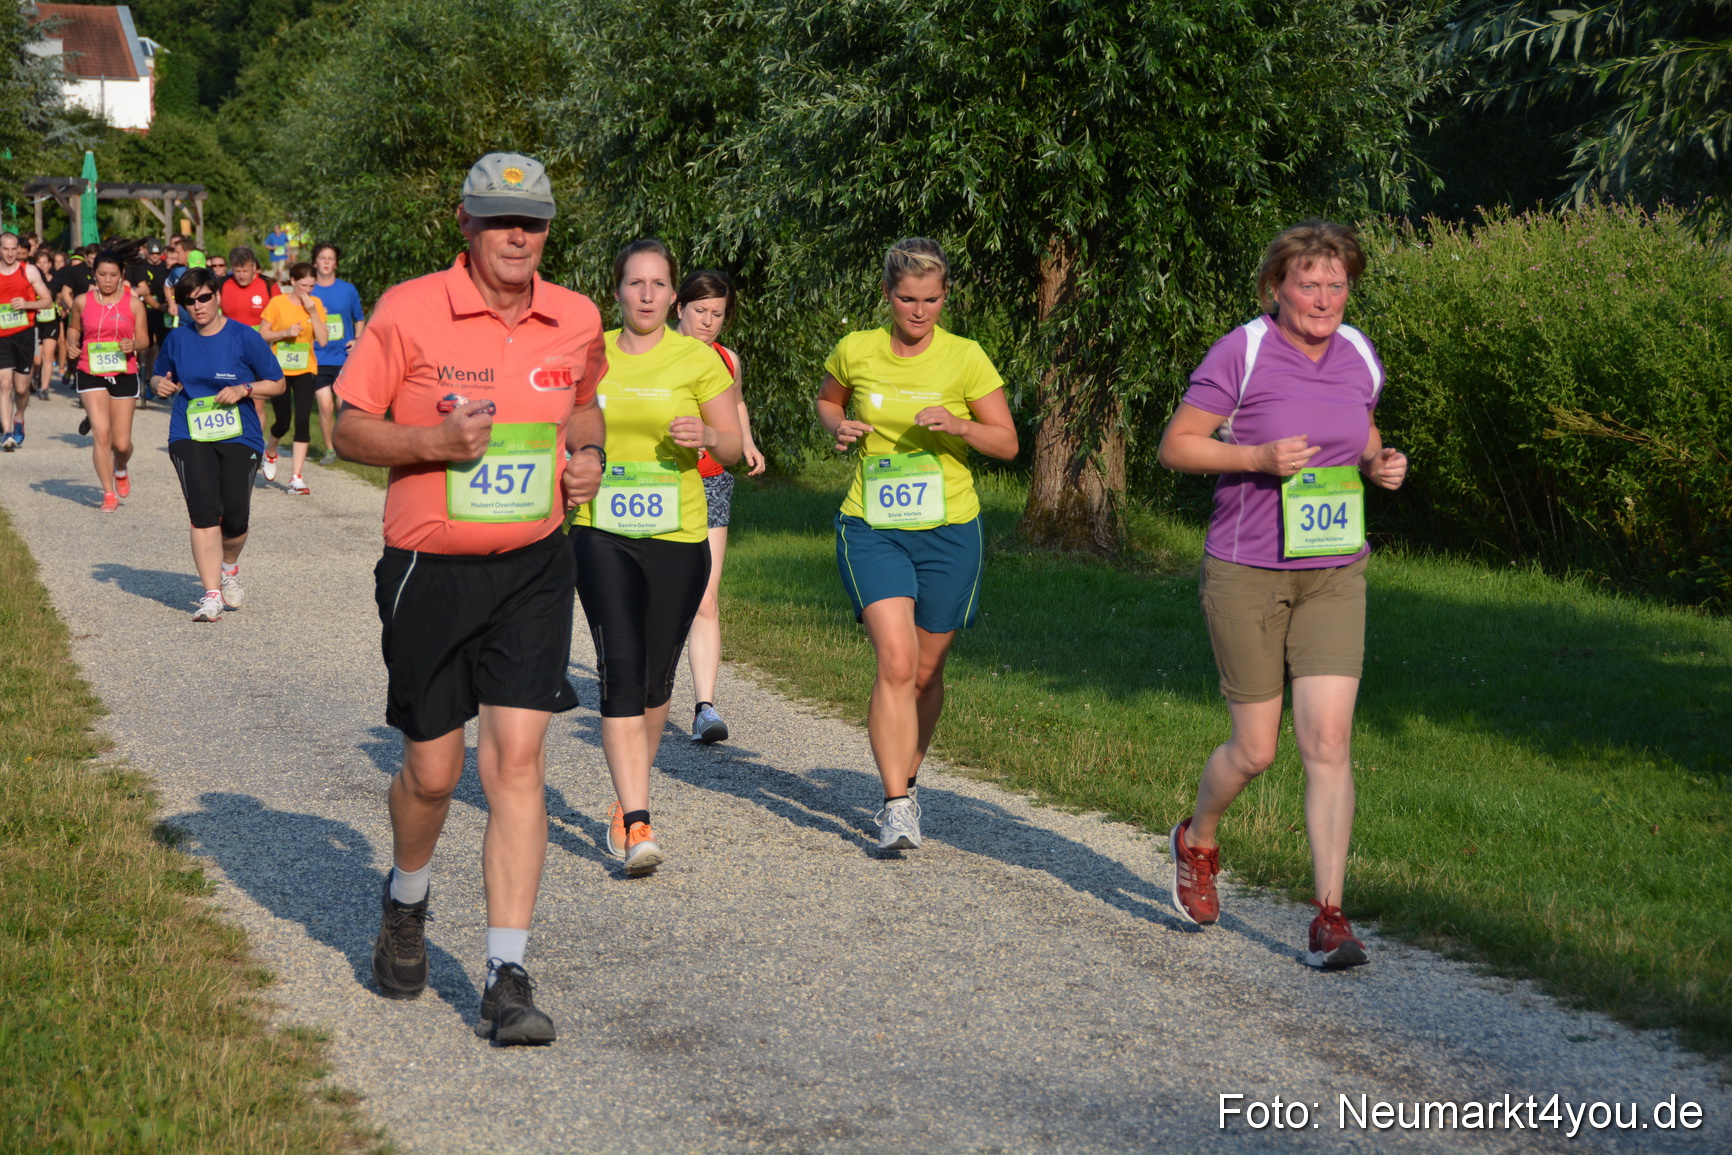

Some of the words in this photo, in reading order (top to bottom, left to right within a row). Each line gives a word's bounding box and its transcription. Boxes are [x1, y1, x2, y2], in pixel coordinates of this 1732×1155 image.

[97, 354, 118, 365] 358
[286, 353, 299, 362] 54
[437, 366, 494, 382] Wendl
[194, 411, 235, 430] 1496
[470, 464, 536, 494] 457
[611, 493, 663, 518] 668
[879, 482, 928, 508] 667
[1300, 502, 1348, 531] 304
